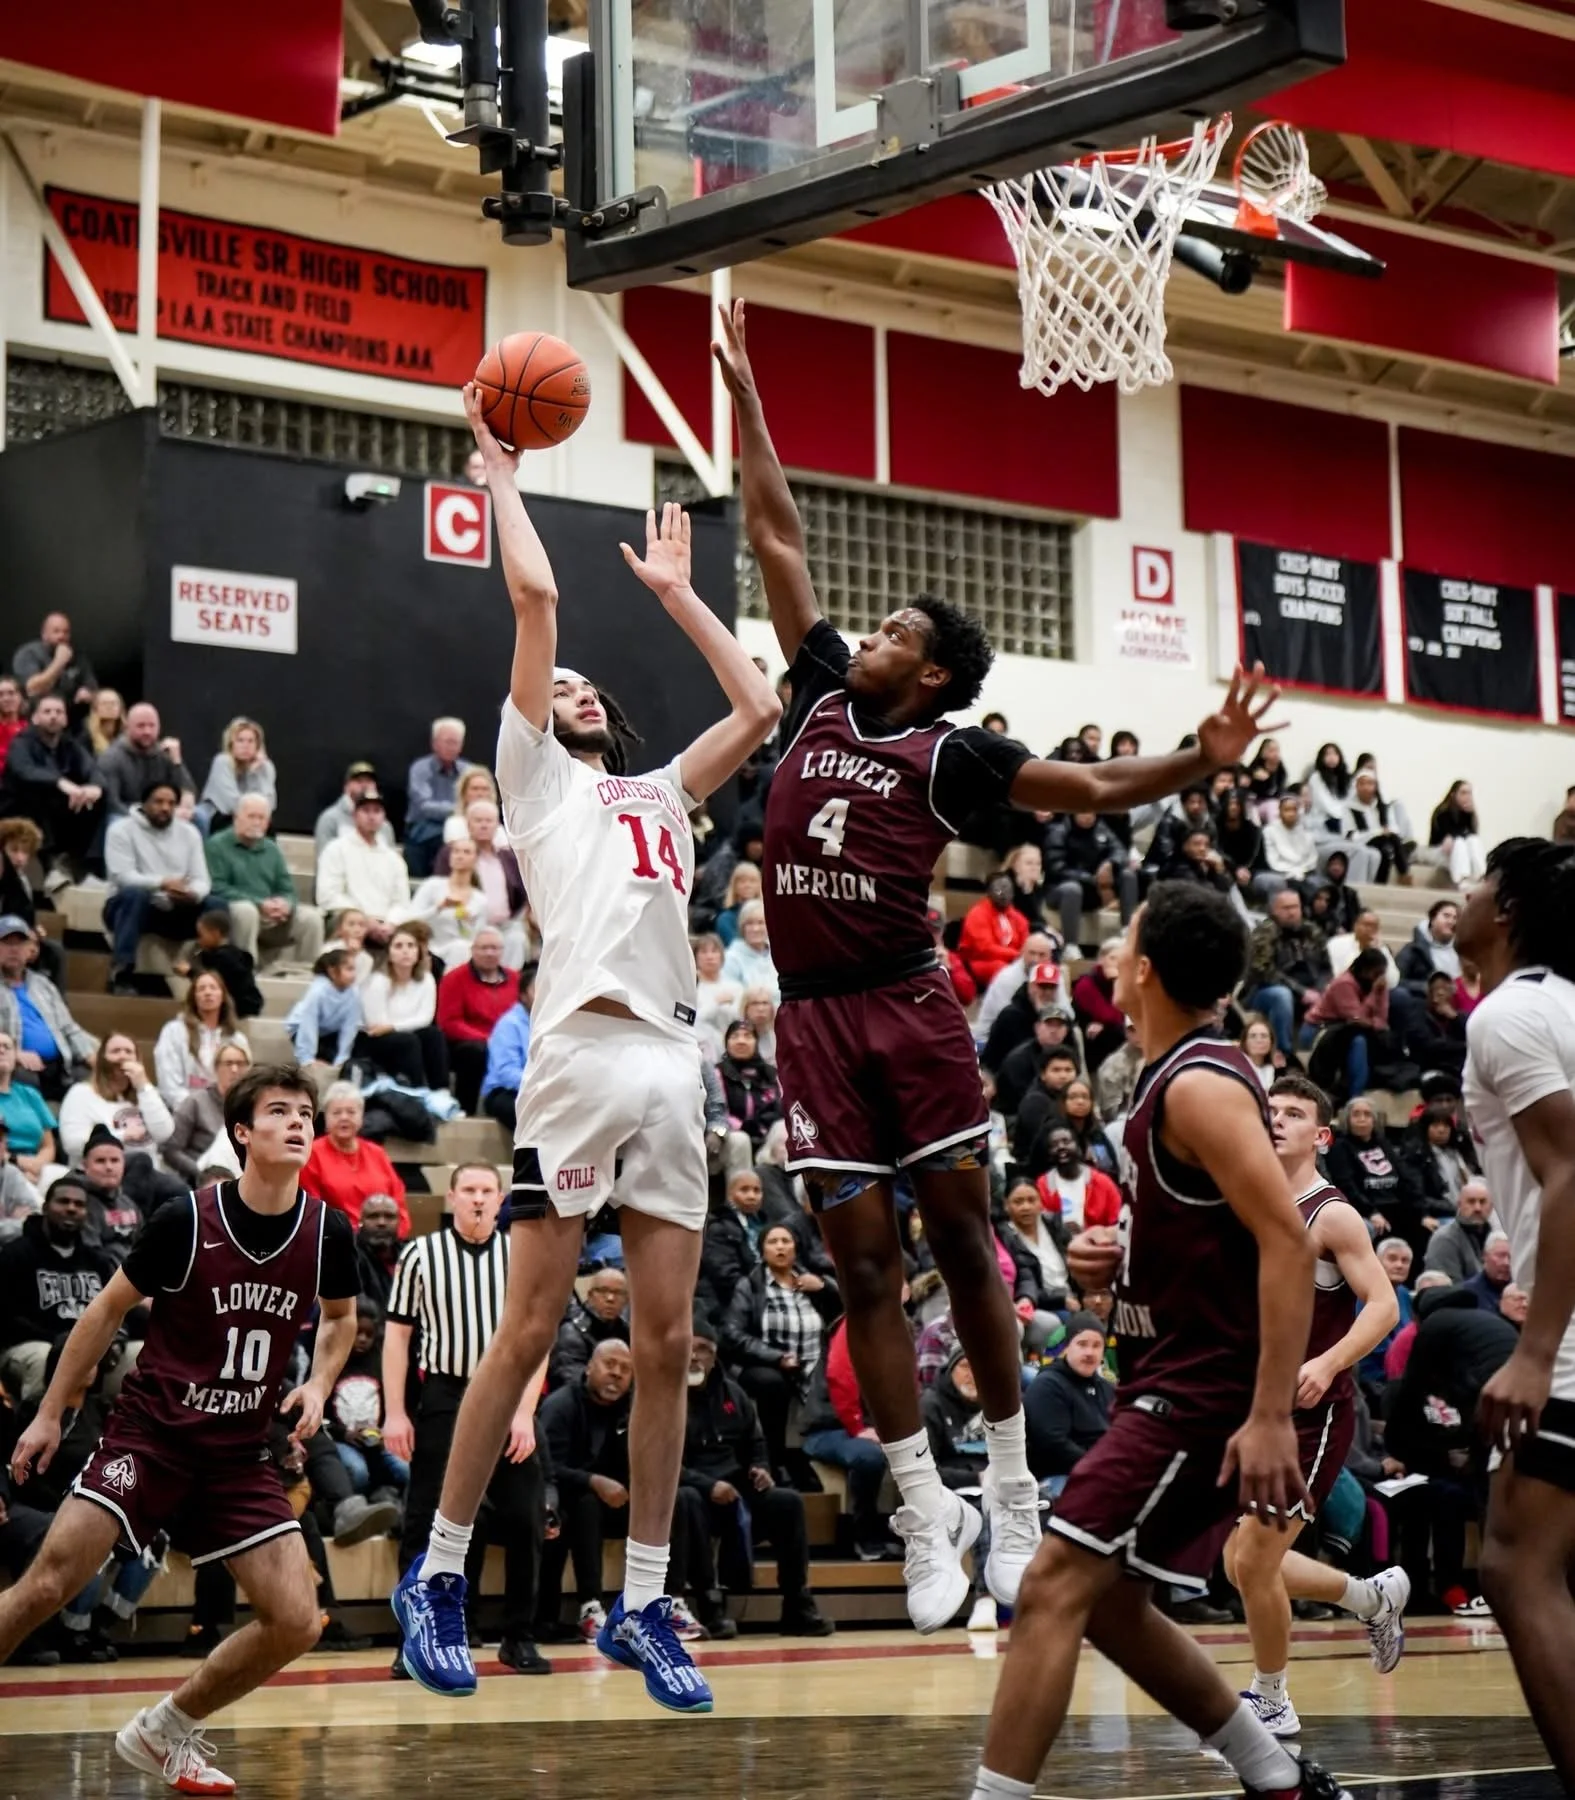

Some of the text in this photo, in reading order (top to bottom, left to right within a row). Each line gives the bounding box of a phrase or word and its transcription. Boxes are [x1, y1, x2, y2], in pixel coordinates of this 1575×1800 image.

[62, 203, 241, 269] COATSVILLE
[300, 247, 360, 292] HIGH
[373, 263, 470, 312] SCHOOL
[195, 268, 351, 325] TRACK AND FIELD
[223, 311, 274, 345] STATE
[282, 321, 388, 366] CHAMPIONS
[394, 342, 434, 374] AAA
[434, 494, 482, 554] C
[178, 580, 291, 613] RESERVED
[1137, 550, 1170, 600] D
[198, 610, 271, 637] SEATS
[801, 750, 902, 799] LOWER
[807, 797, 850, 858] 4
[618, 813, 687, 896] 14
[775, 863, 877, 904] MERION
[557, 1165, 596, 1191] CVILLE
[211, 1281, 299, 1321] LOWER
[219, 1326, 272, 1382] 10
